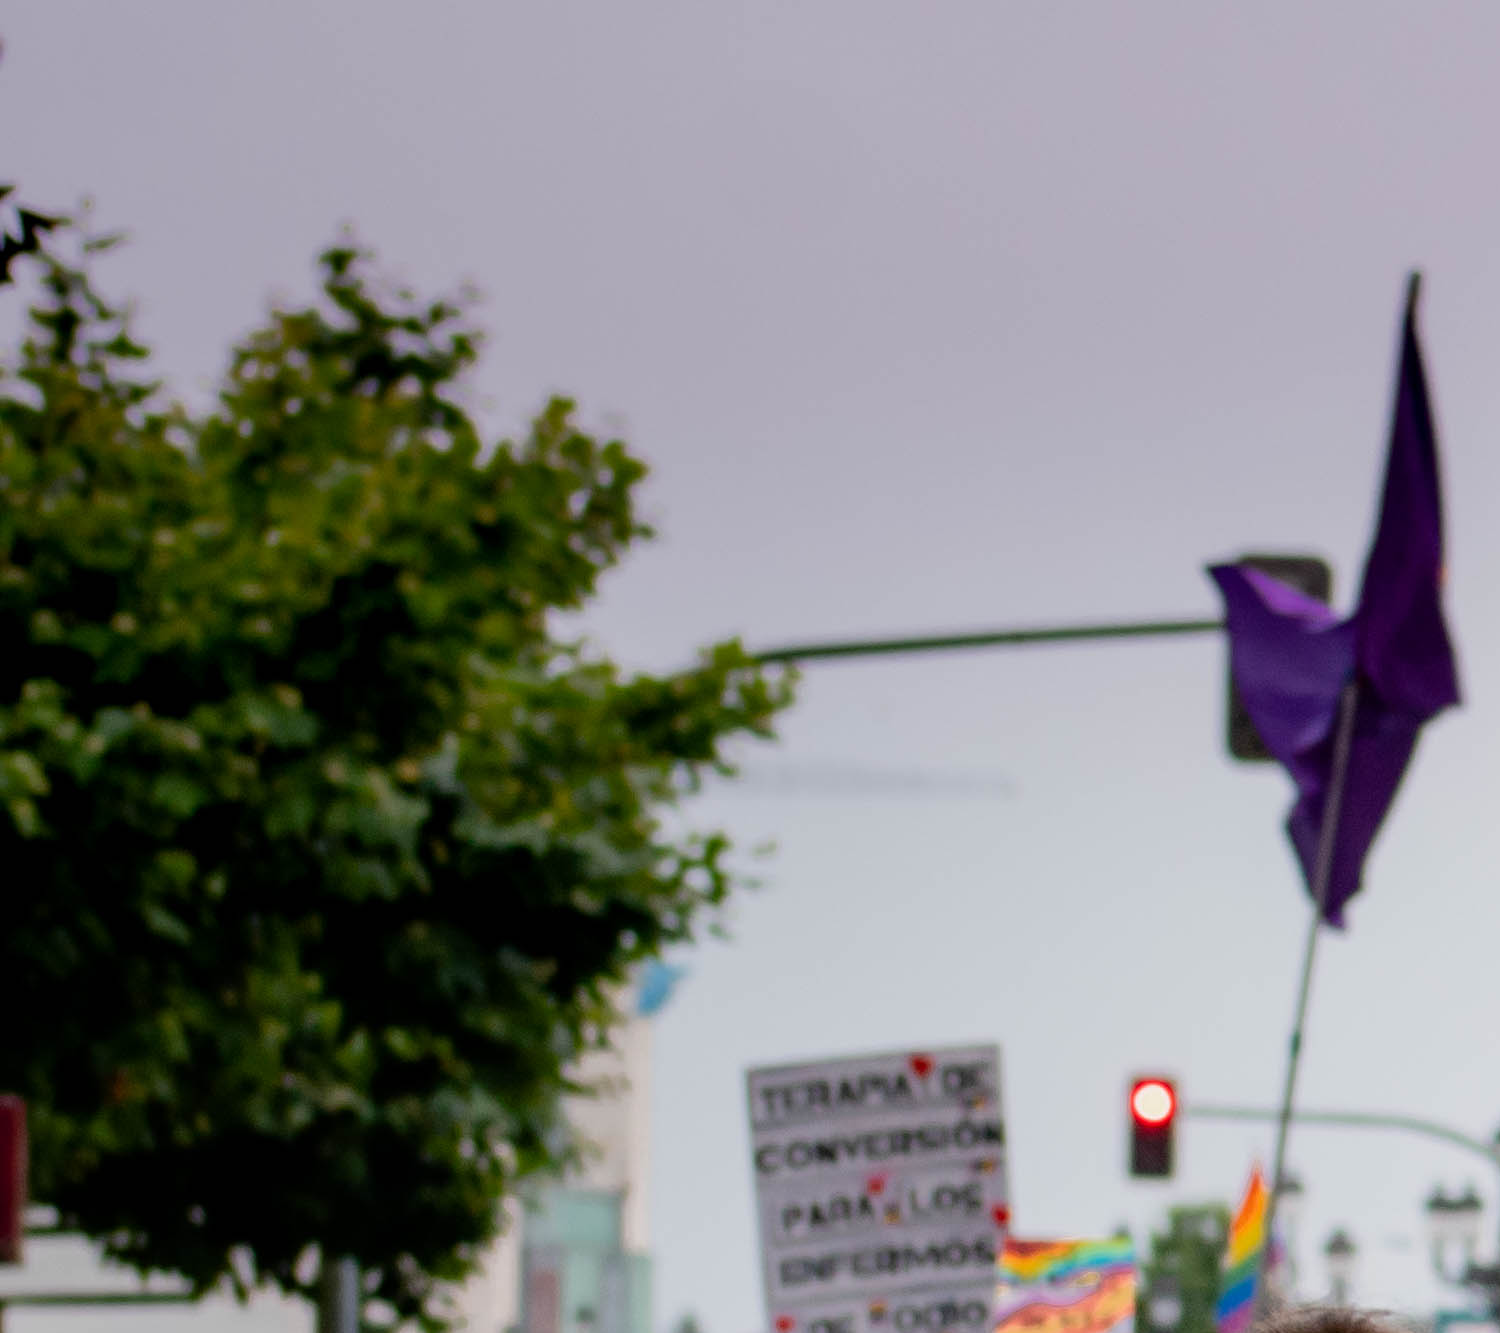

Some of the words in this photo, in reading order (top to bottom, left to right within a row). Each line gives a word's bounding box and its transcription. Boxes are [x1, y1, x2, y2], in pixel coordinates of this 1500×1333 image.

[760, 1074, 912, 1115] TERAPIA
[942, 1062, 988, 1098] DE
[782, 1194, 875, 1231] PARA
[909, 1183, 984, 1217] LOS
